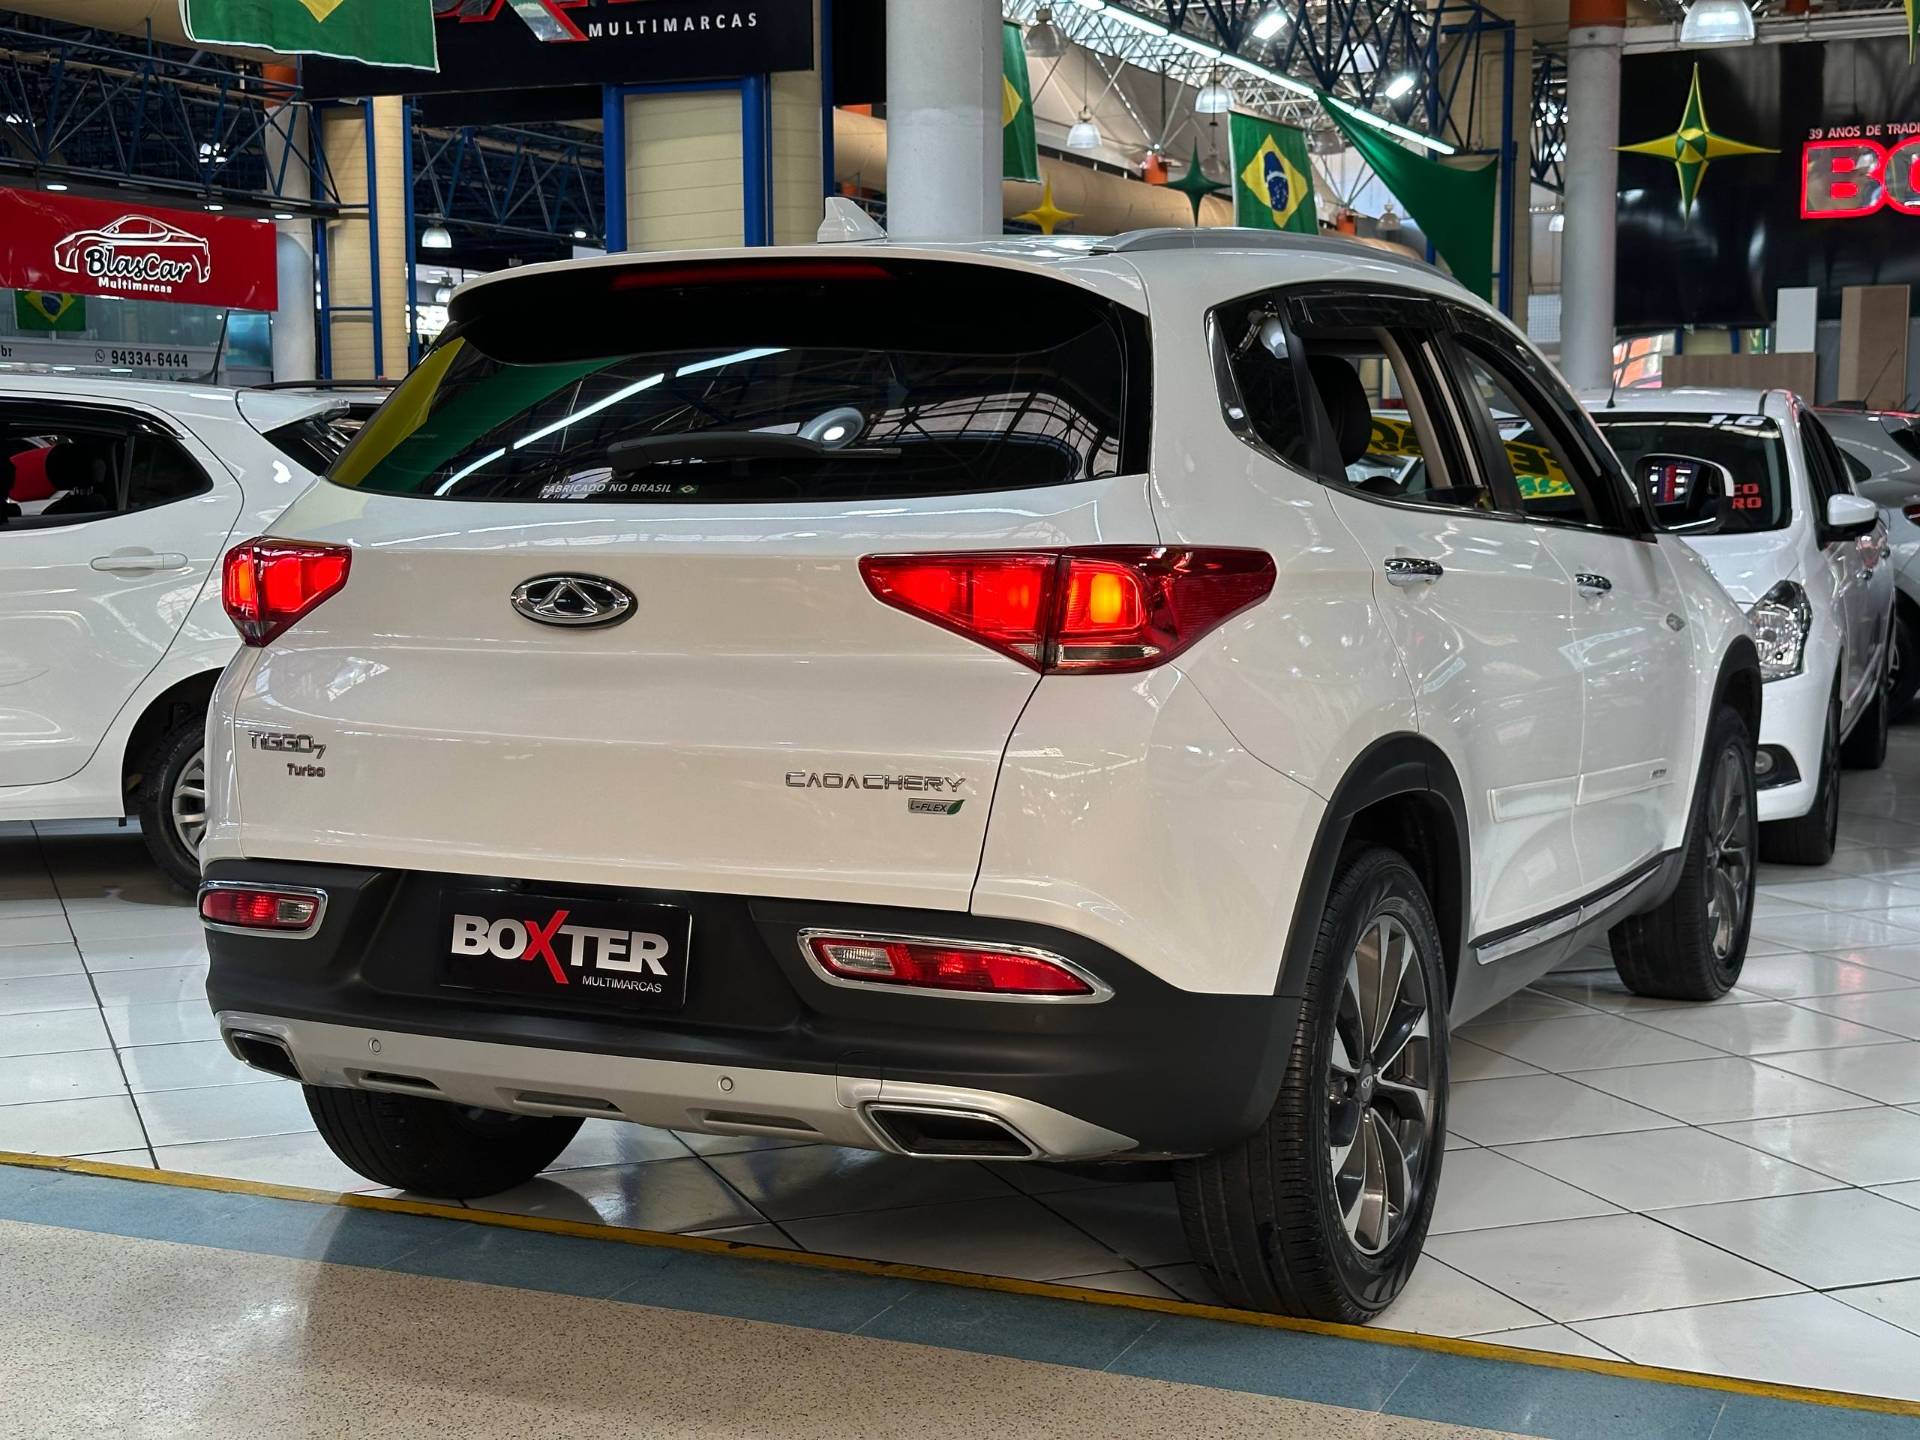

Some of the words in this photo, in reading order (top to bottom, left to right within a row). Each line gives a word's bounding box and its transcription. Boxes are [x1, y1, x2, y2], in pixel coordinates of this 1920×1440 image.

[588, 12, 758, 38] MULTIMARCAS
[1808, 128, 1823, 140] 39
[1827, 125, 1861, 139] ANOS
[1865, 124, 1882, 136] DE
[85, 245, 193, 283] BlasCar
[98, 275, 173, 294] Multimarcas
[111, 350, 188, 368] 94334-6444
[1708, 414, 1767, 427] 1.6
[541, 482, 606, 494] FABRICADO
[608, 483, 628, 493] NO
[630, 483, 672, 493] BRASIL
[286, 762, 326, 778] Turbo
[451, 910, 670, 985] BOXTER
[581, 975, 663, 993] MULTIMARCAS
